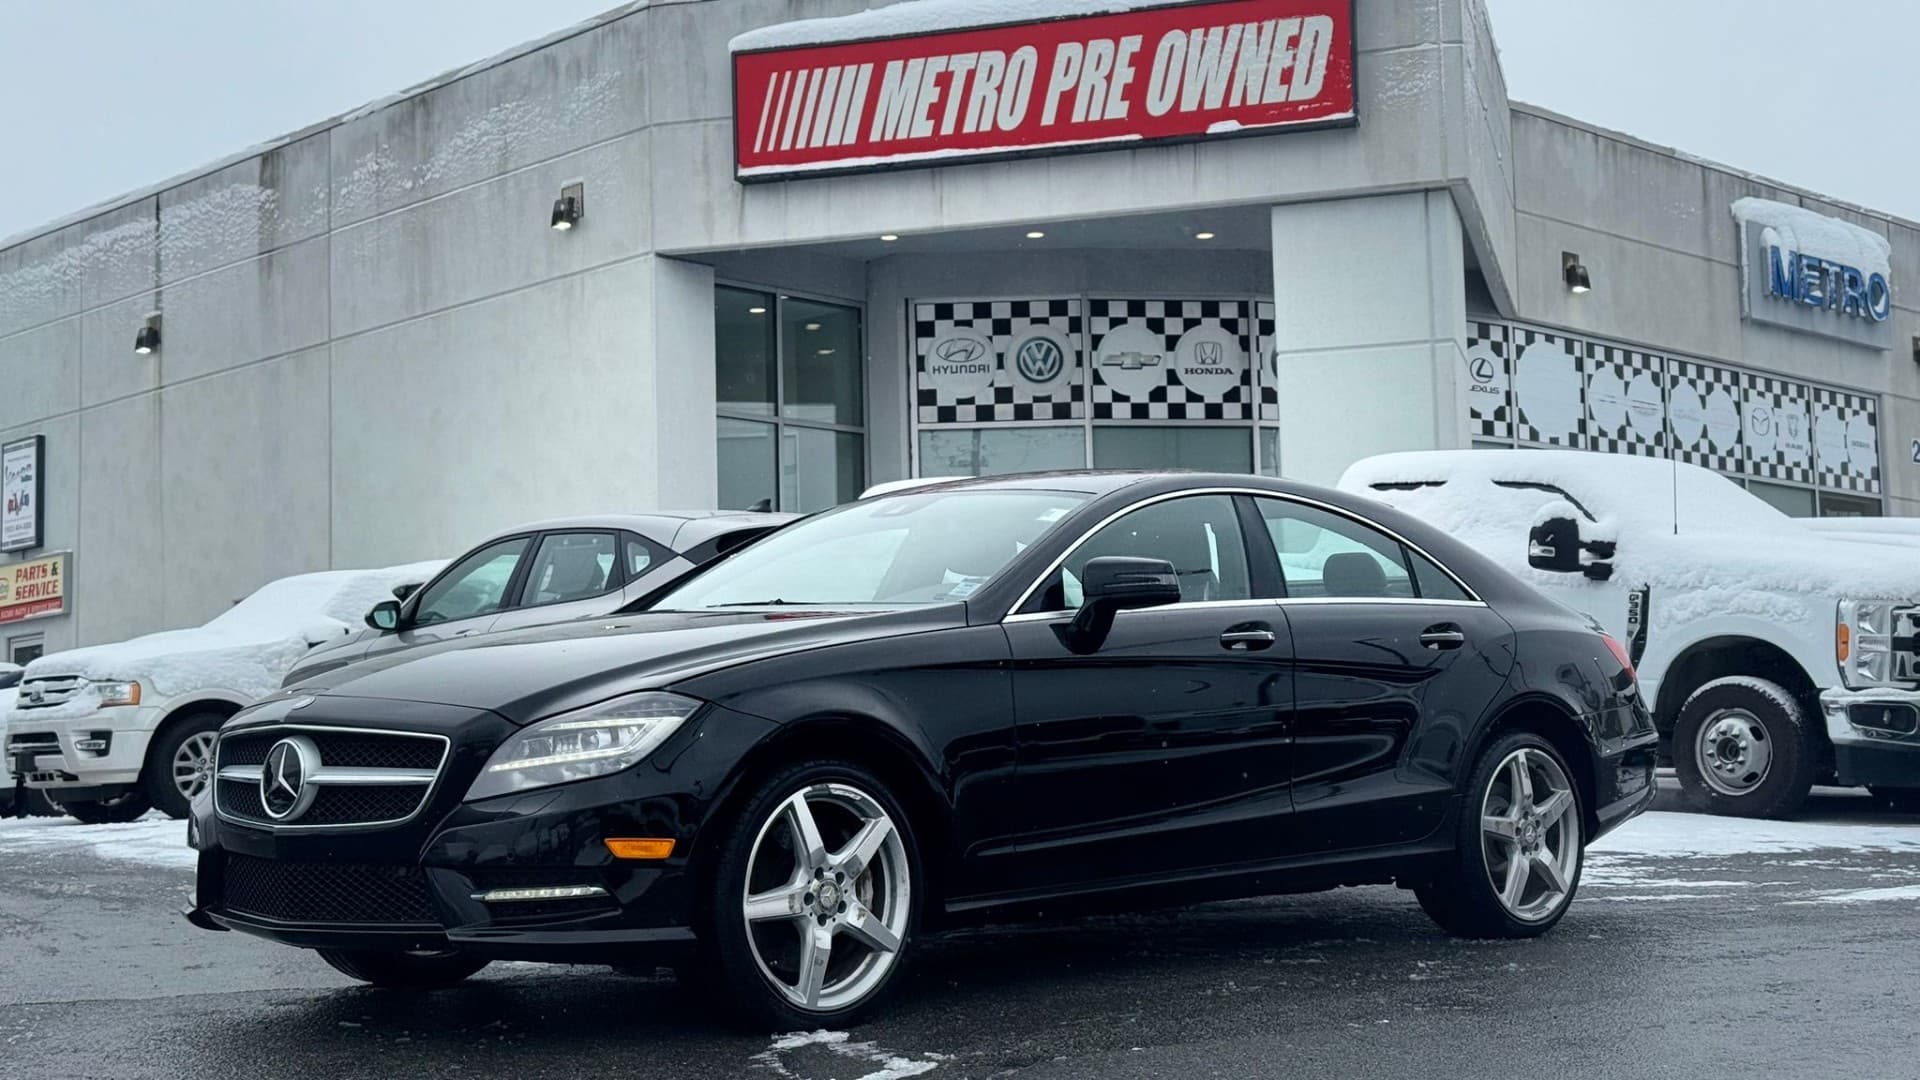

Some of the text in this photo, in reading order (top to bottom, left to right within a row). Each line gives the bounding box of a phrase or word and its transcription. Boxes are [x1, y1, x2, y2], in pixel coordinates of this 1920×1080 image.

[869, 14, 1335, 142] METRO PRE OWNED
[1770, 244, 1890, 322] METRO
[932, 363, 990, 375] HYUNDAI
[1183, 367, 1235, 375] HONDA
[1469, 384, 1499, 395] EXUS
[15, 561, 59, 583] PARTS &
[15, 579, 59, 601] SERVICE
